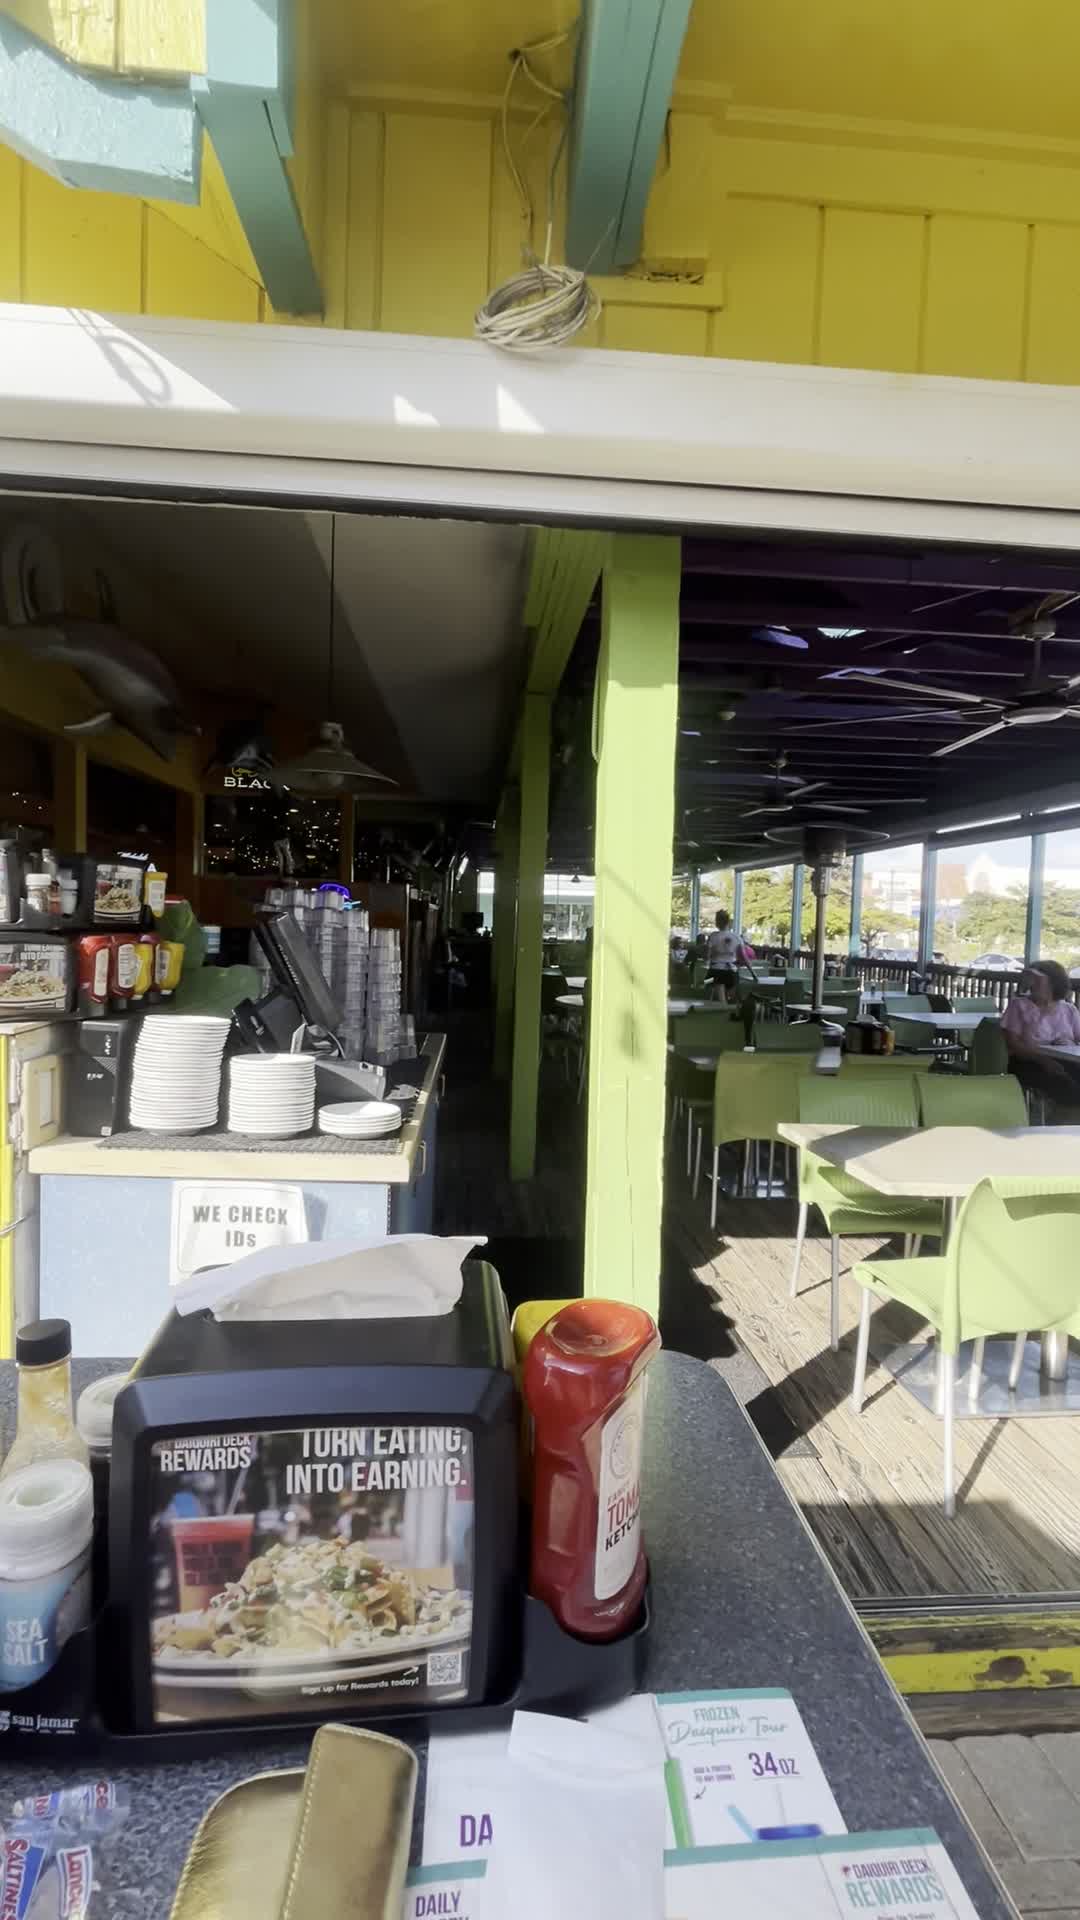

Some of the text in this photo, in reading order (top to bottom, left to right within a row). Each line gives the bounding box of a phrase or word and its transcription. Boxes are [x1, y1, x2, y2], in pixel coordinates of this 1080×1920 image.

[192, 1205, 288, 1226] WE CHECK
[225, 1229, 257, 1248] IDs
[303, 1427, 468, 1458] TURN EATING,
[160, 1446, 252, 1473] REWARDS
[286, 1458, 468, 1495] INTO EARNING.
[6, 1617, 44, 1642] SEA
[3, 1638, 49, 1664] SALT
[322, 1684, 335, 1693] up
[336, 1682, 349, 1692] for
[350, 1680, 389, 1691] Rewards
[391, 1677, 420, 1688] today!
[12, 1714, 80, 1730] san jamar
[693, 1705, 741, 1722] FROZEN
[748, 1716, 789, 1737] Tour
[852, 1859, 932, 1879] DAIQUIRI DECK
[846, 1875, 944, 1907] REWARDS
[415, 1890, 462, 1917] DAILY
